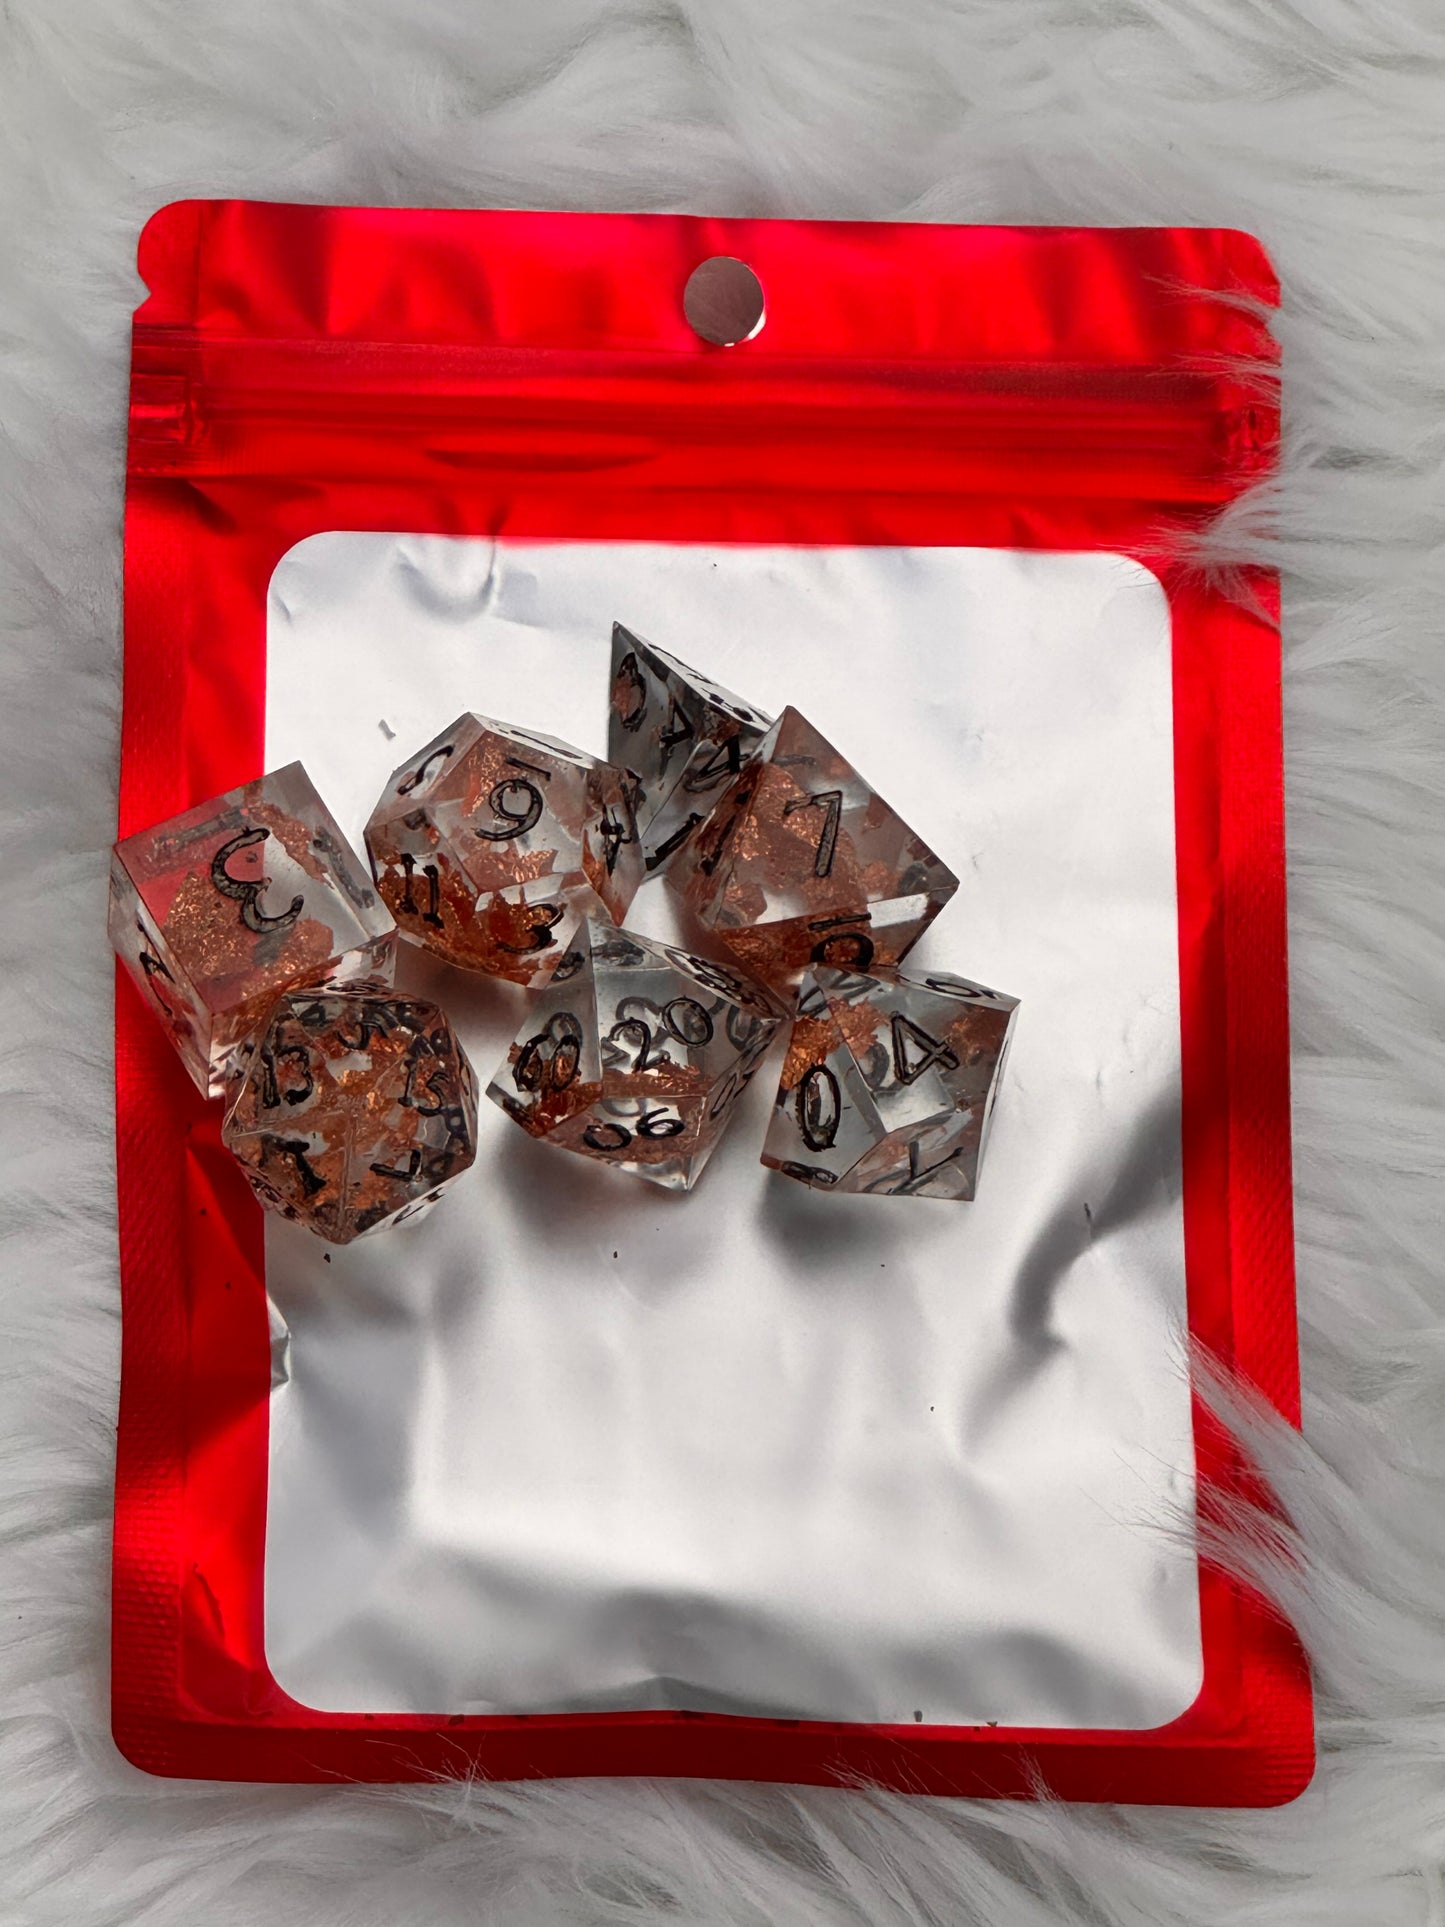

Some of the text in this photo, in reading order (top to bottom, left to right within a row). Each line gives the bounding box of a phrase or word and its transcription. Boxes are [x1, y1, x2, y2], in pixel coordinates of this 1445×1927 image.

[783, 790, 843, 878] 7
[211, 827, 304, 934] 3
[609, 997, 714, 1074] 20
[891, 1011, 960, 1085] 4
[797, 1064, 842, 1152] 0
